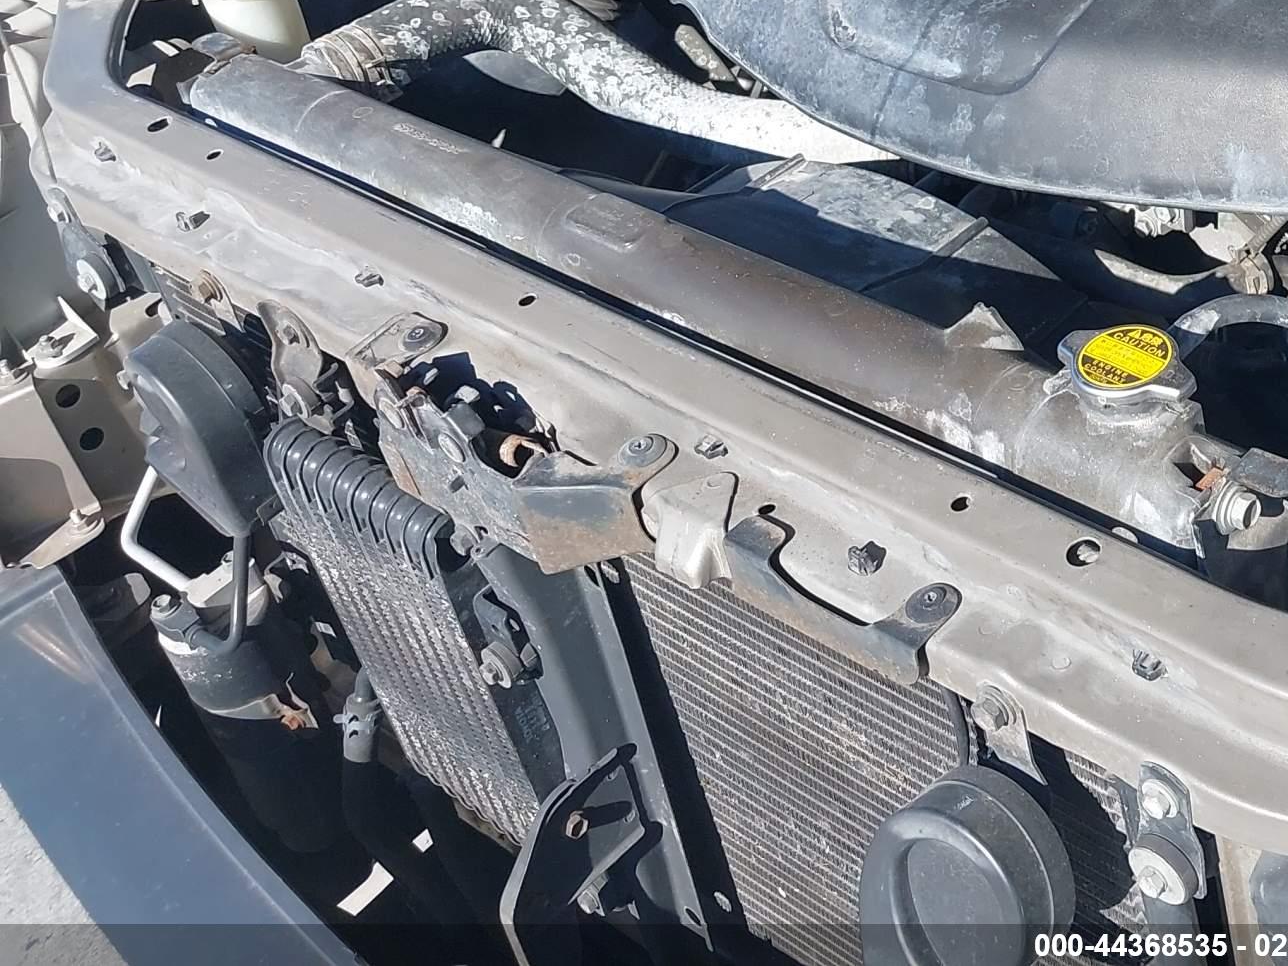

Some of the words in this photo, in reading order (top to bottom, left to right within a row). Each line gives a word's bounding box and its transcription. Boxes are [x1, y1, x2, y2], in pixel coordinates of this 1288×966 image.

[1113, 332, 1166, 357] CAUTION
[1084, 363, 1127, 384] COOLANT
[1092, 360, 1128, 379] ENGINE
